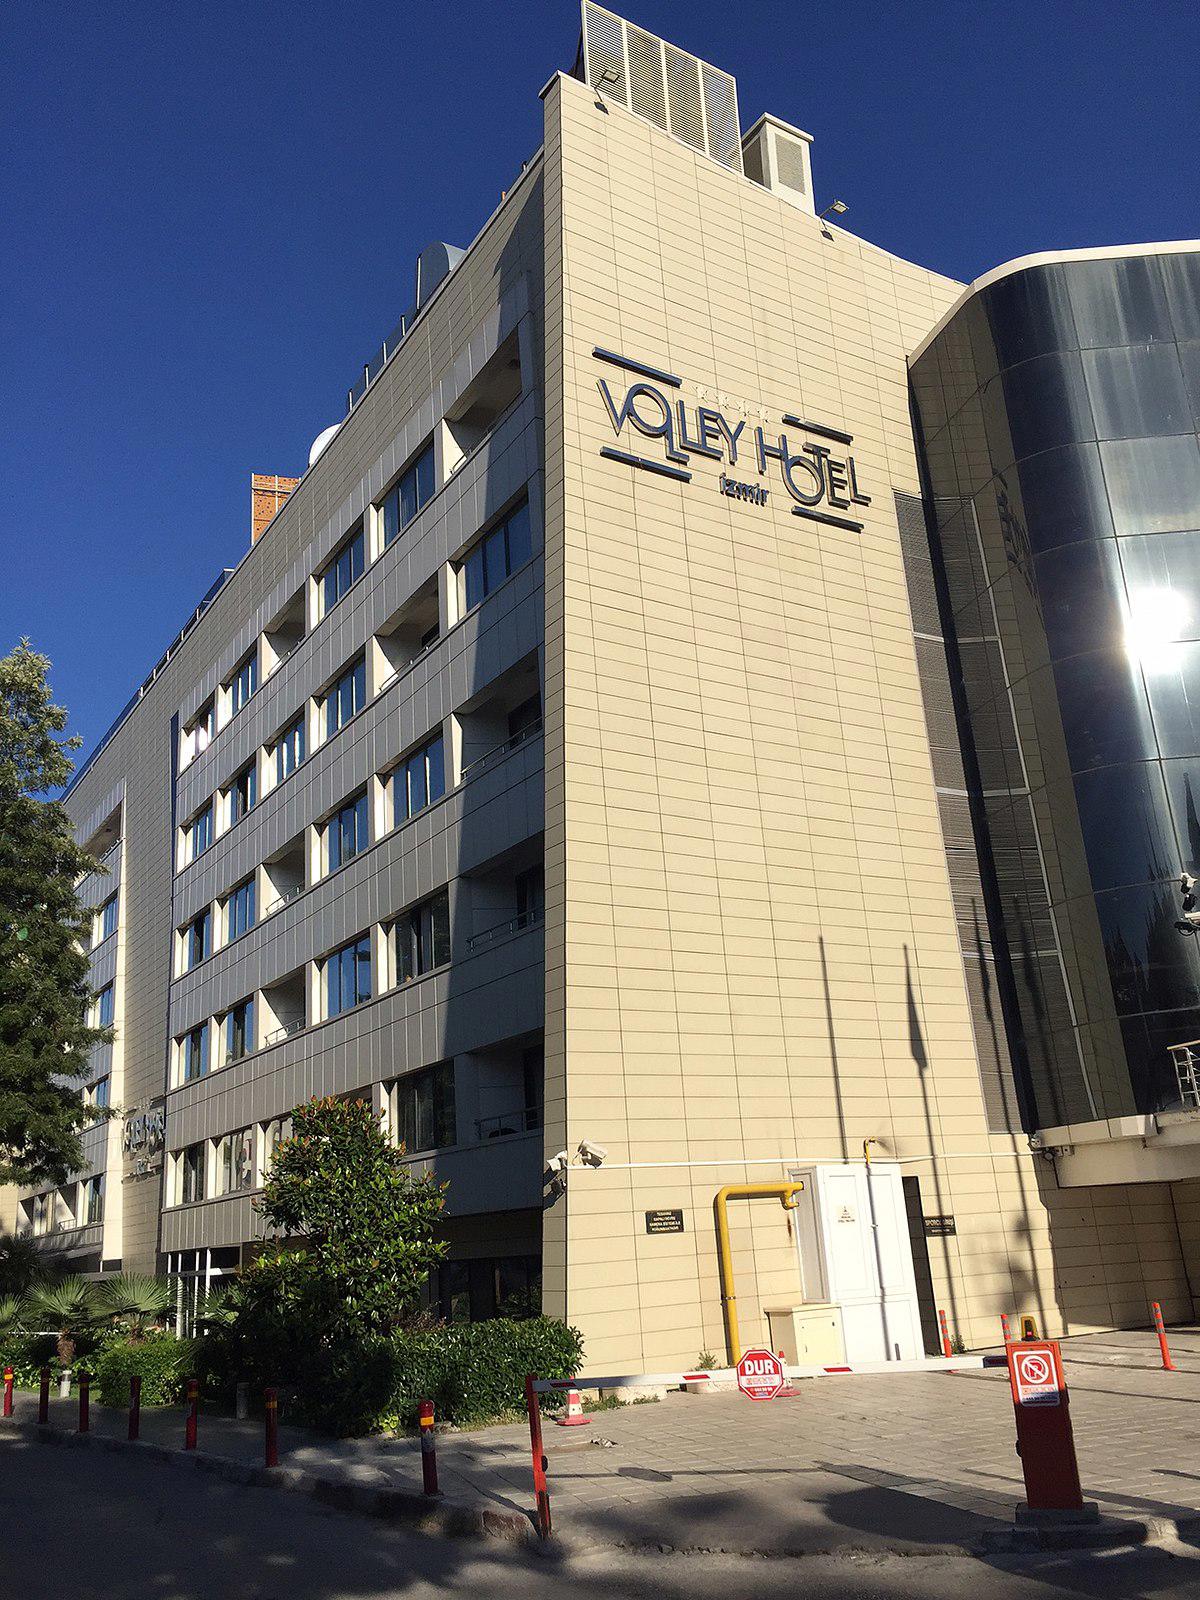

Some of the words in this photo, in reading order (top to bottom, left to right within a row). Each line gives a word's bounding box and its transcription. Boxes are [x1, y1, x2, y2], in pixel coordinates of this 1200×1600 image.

[596, 378, 746, 466] VOLLEY
[755, 426, 872, 510] HOTEL
[744, 1359, 775, 1375] DUR
